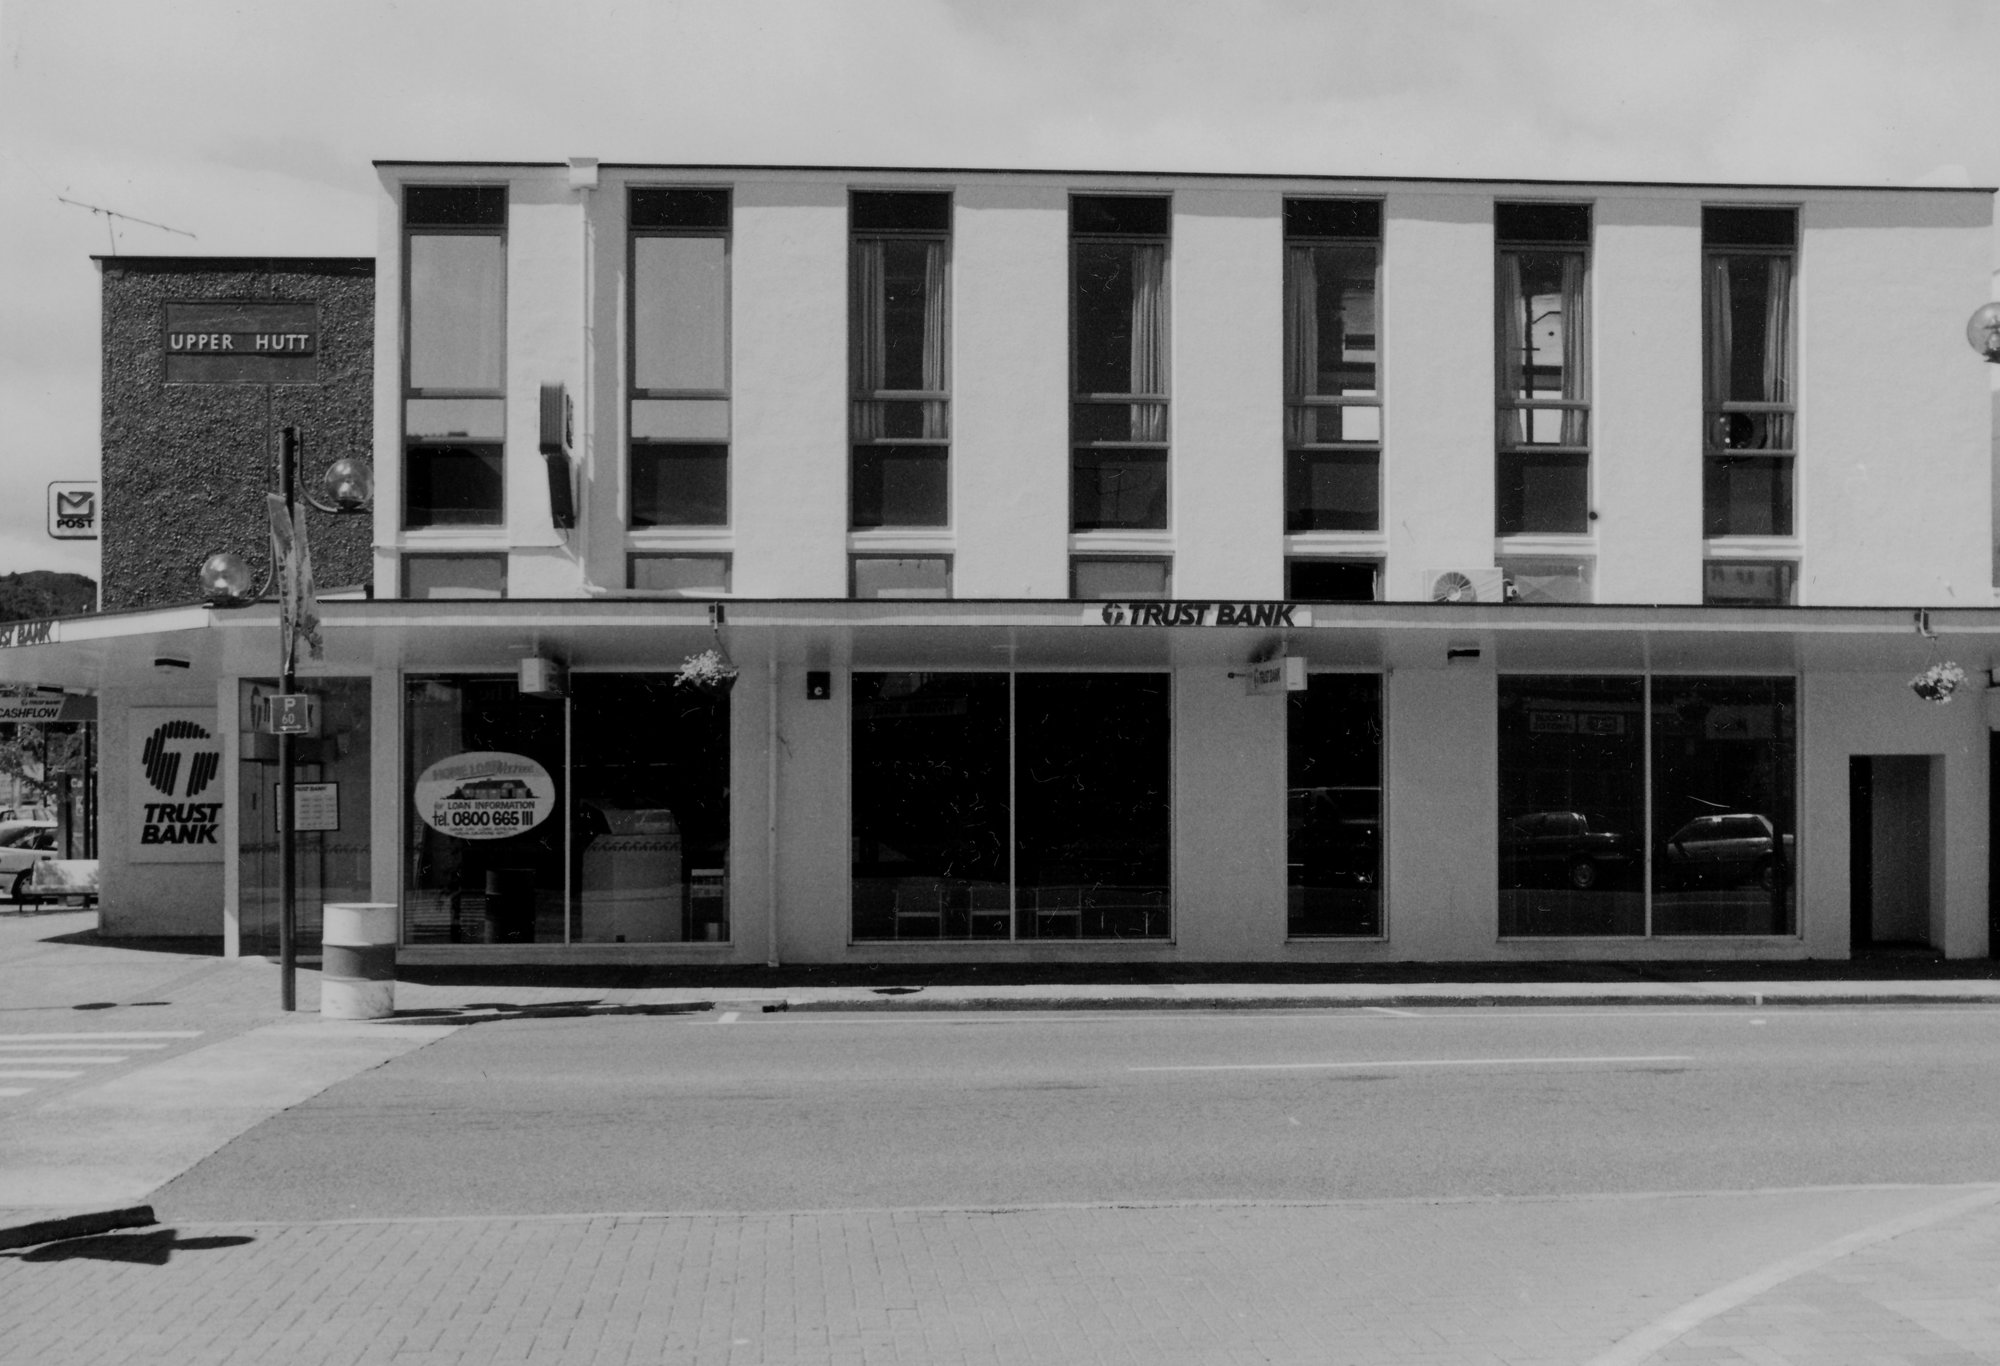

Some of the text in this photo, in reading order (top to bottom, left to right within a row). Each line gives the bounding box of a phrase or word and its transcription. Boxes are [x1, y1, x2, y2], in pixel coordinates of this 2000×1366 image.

[171, 333, 309, 350] UPPER HUTT
[57, 518, 94, 529] POST
[1129, 603, 1298, 628] TRUST BANK
[17, 620, 52, 646] BANK
[284, 698, 296, 712] P
[282, 713, 295, 725] 60
[447, 802, 471, 810] LOAN
[474, 801, 535, 810] INFORMATION
[141, 803, 223, 844] TRUST BANK
[432, 811, 533, 827] tel. 0800 665 111
